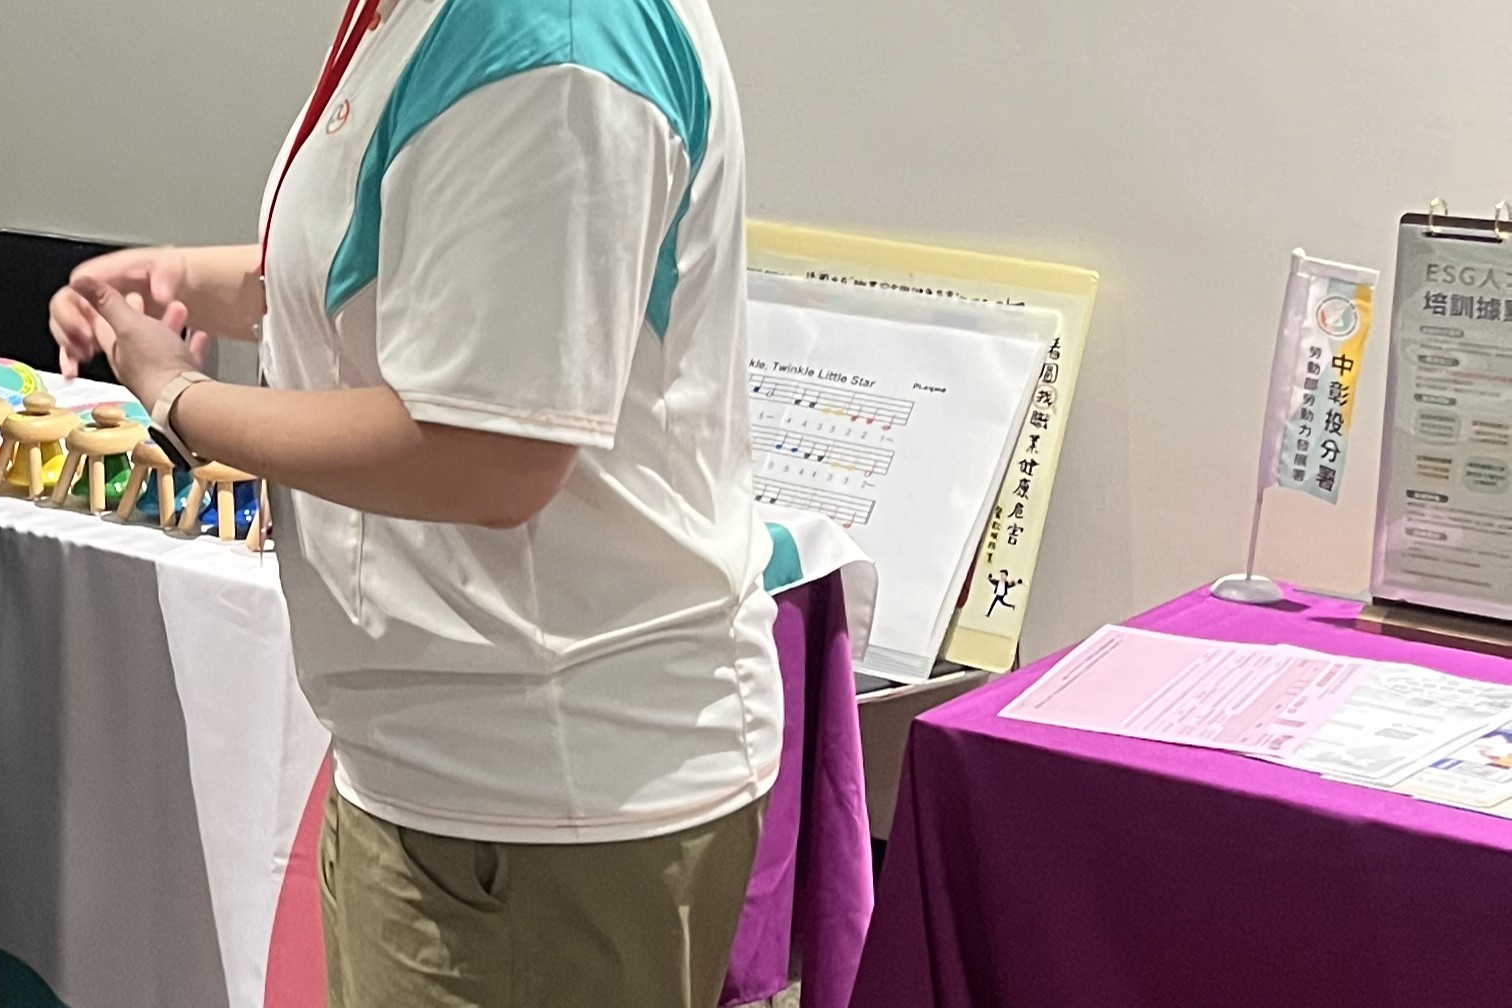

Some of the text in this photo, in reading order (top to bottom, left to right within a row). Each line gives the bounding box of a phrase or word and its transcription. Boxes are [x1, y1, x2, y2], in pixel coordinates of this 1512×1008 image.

[773, 361, 815, 377] Twinkle
[818, 368, 847, 384] Little
[850, 375, 876, 388] Star
[1316, 354, 1354, 492] 中彰投分署
